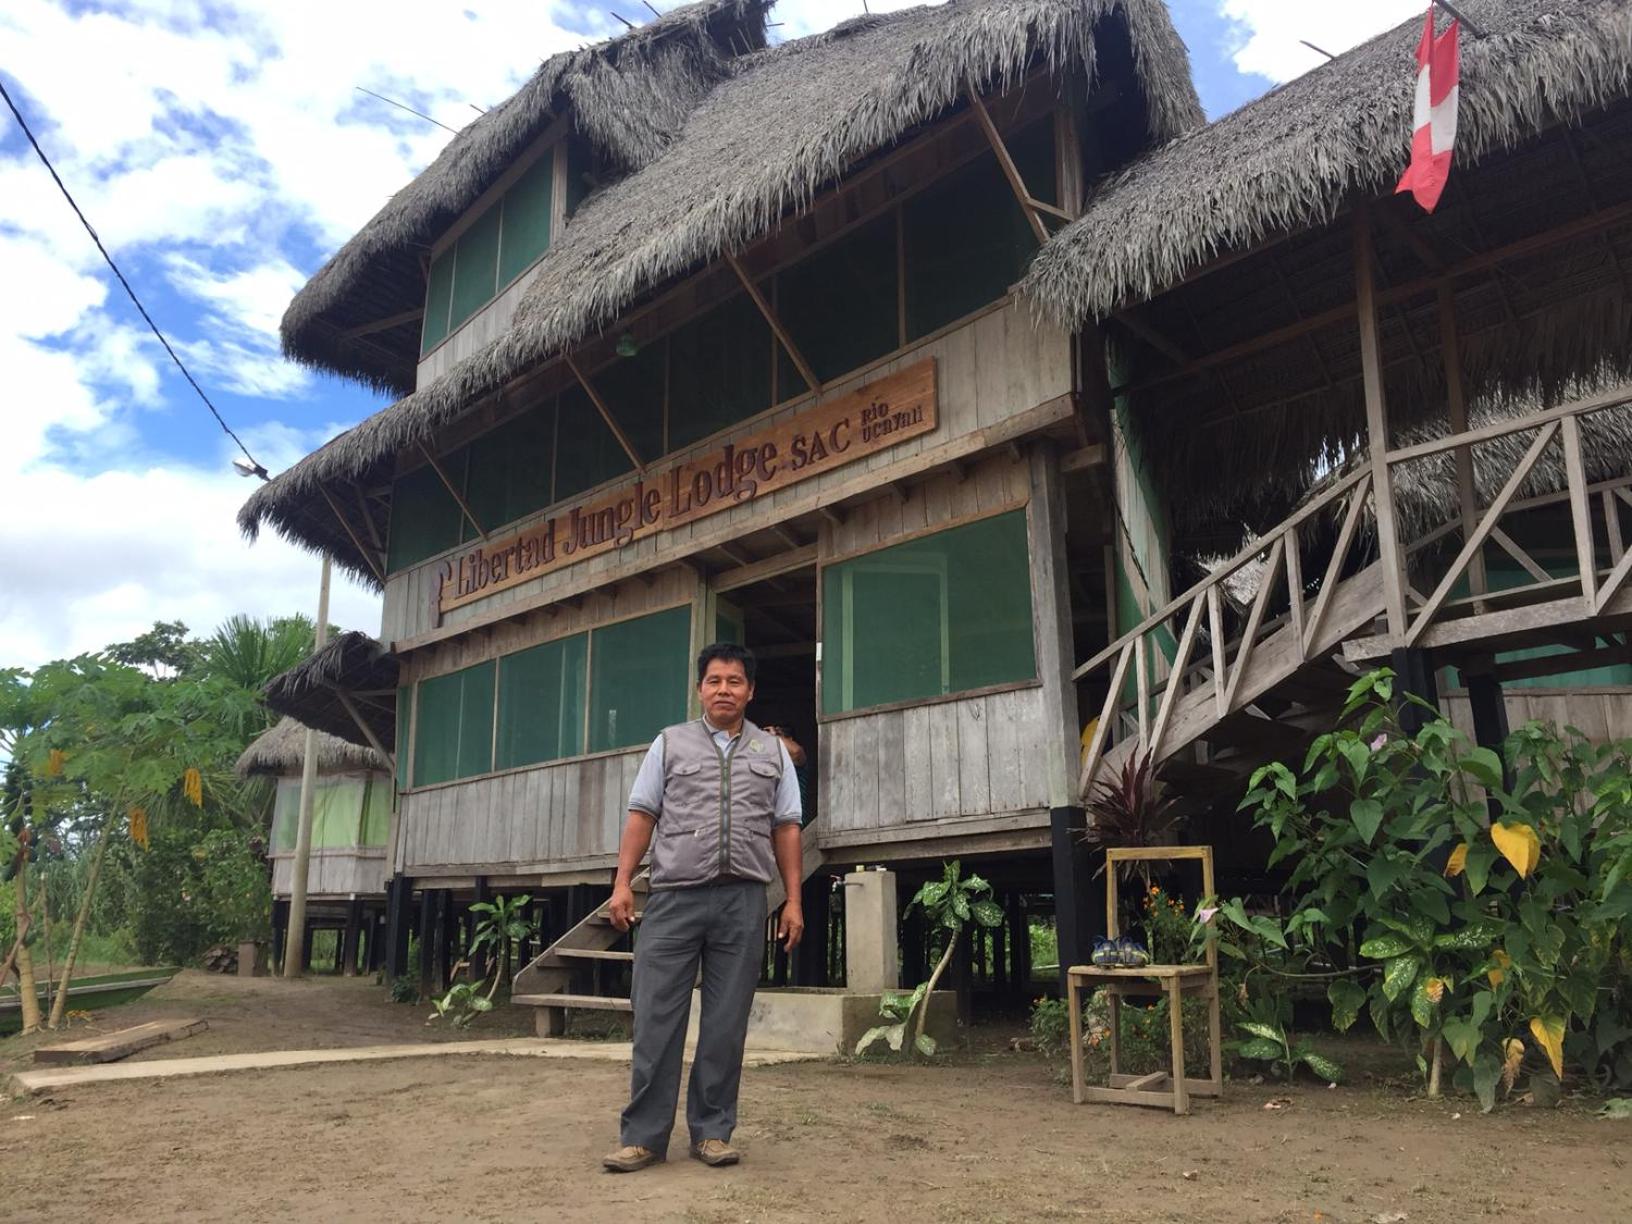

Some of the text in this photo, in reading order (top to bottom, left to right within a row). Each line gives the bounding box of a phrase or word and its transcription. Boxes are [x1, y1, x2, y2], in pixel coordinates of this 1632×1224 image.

[454, 418, 850, 601] Libertad Jungle Lodge SAC
